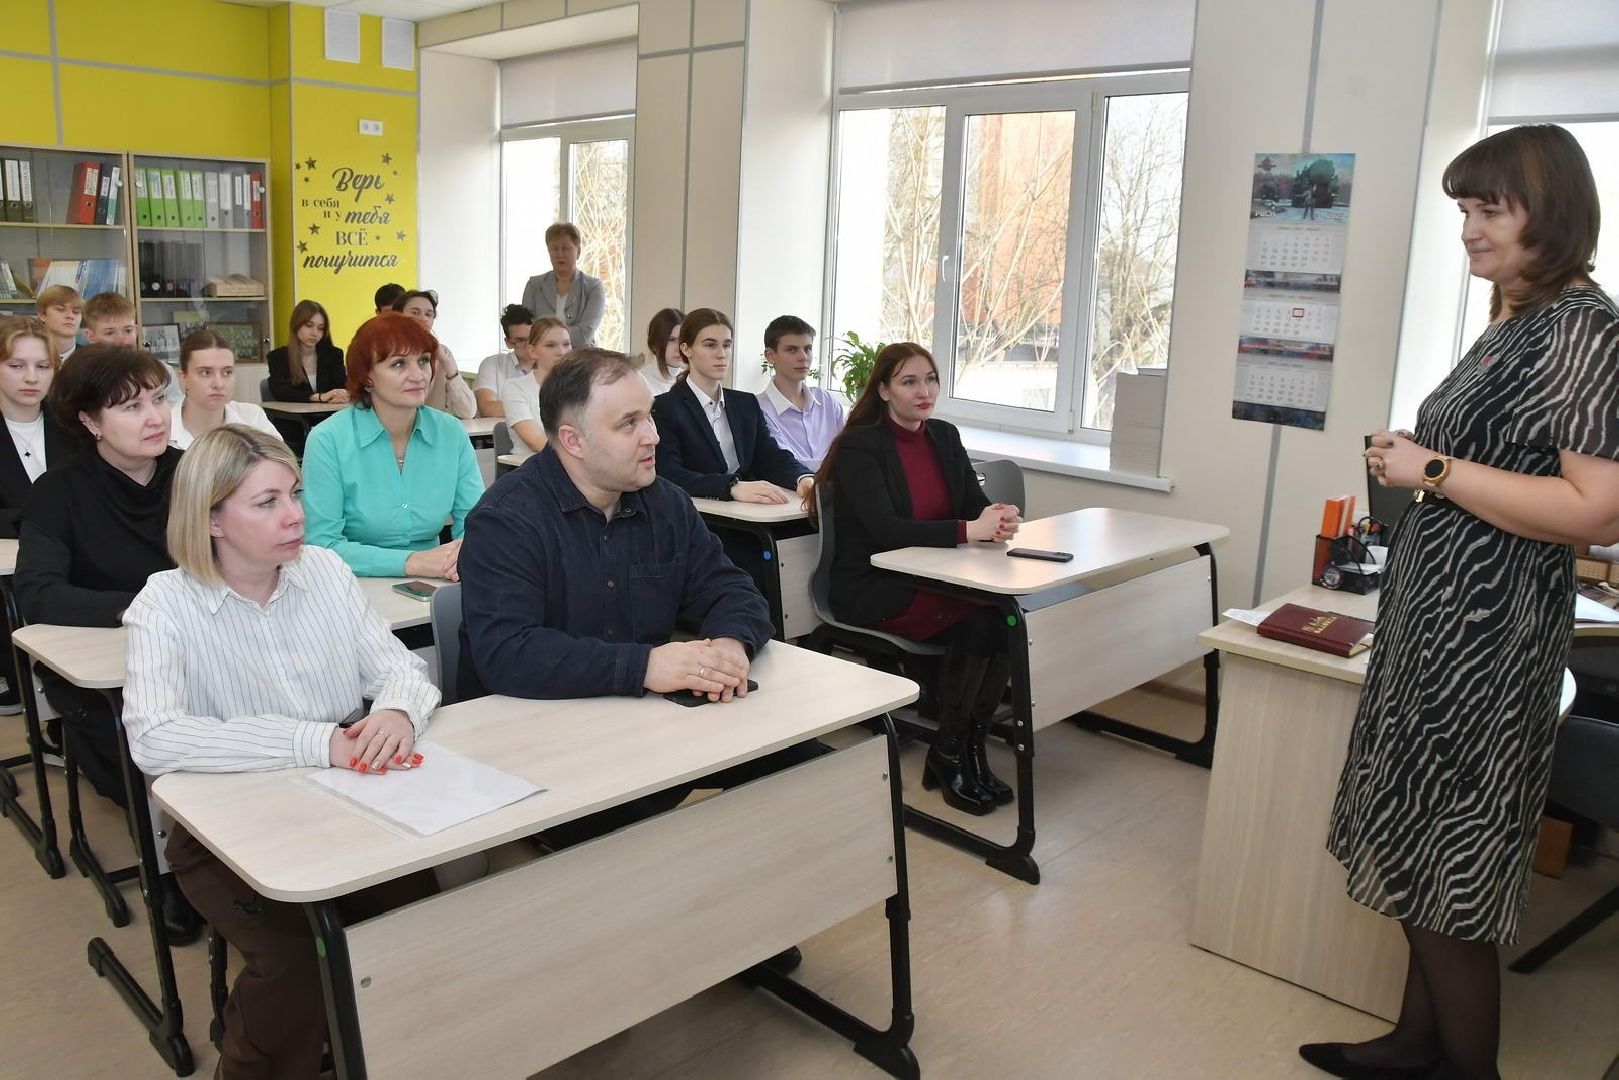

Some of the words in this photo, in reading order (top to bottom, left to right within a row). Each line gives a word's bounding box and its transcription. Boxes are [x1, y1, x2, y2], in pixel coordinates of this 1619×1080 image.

[332, 167, 385, 203] Верь
[301, 199, 309, 208] в
[313, 197, 340, 208] себя
[323, 210, 331, 219] и
[335, 211, 342, 222] у
[345, 205, 391, 225] тебя
[335, 228, 369, 246] ВСЁ
[303, 251, 398, 274] получится
